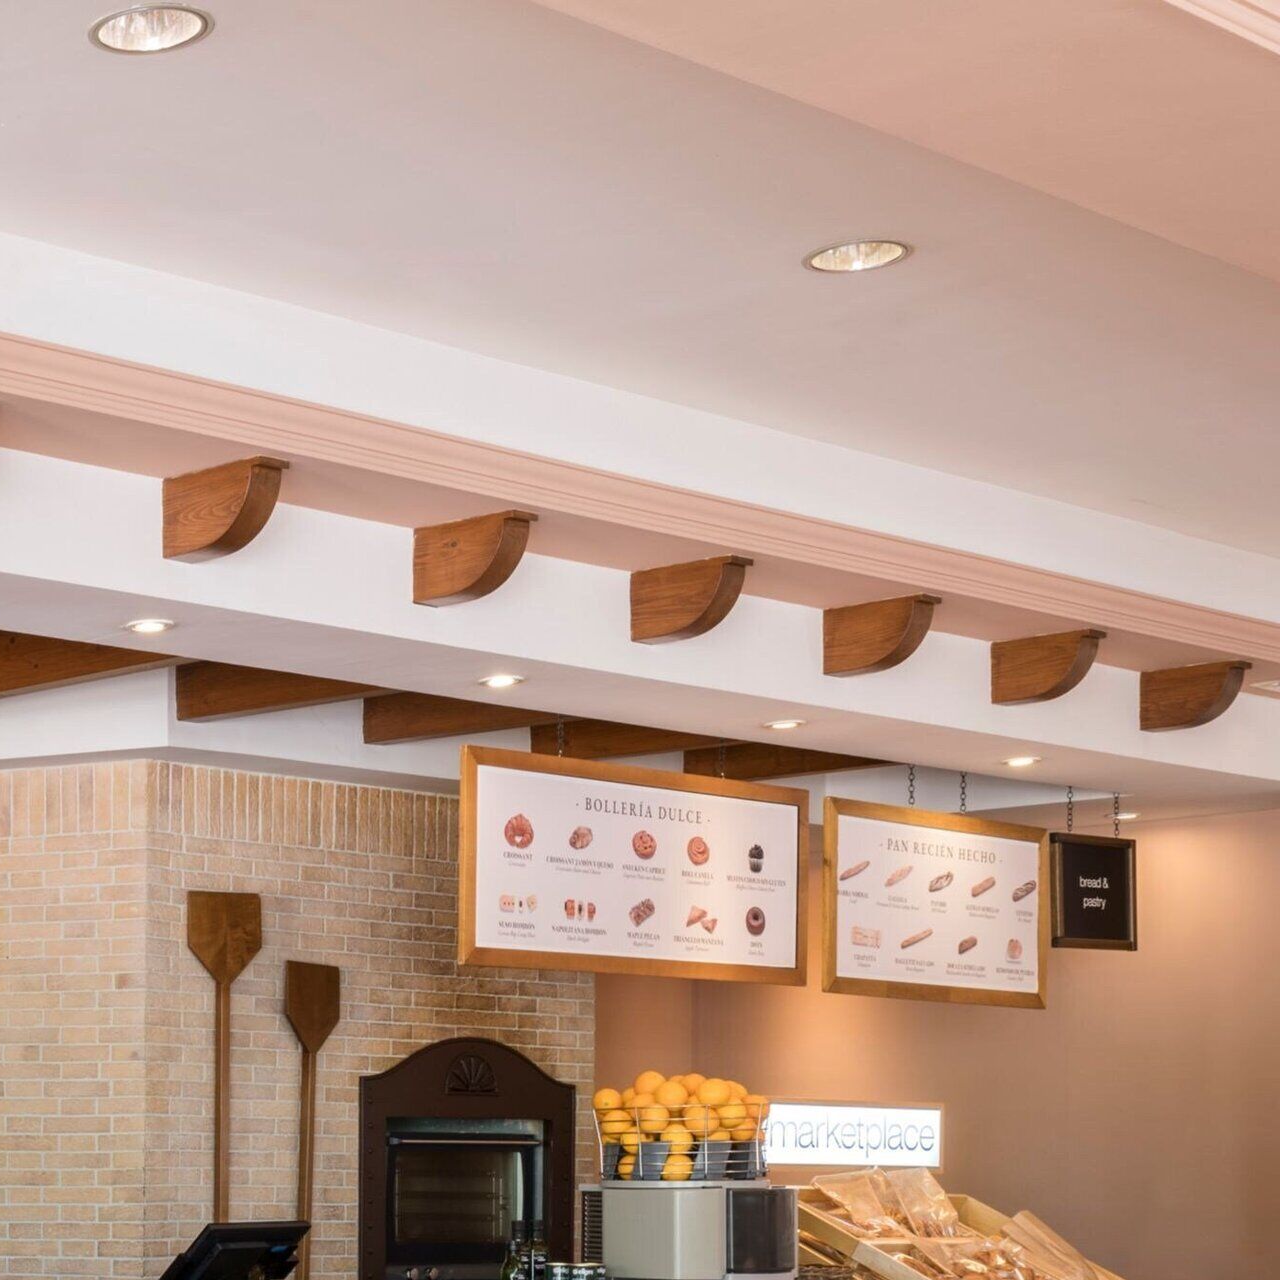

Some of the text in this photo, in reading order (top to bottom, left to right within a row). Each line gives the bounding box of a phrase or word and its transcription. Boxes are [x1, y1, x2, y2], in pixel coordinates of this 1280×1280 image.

[585, 796, 703, 824] BOLLERÍA DULCE
[887, 838, 909, 852] PAN
[958, 847, 996, 864] HECHO
[1079, 875, 1110, 889] bread &
[1083, 896, 1107, 910] pastry
[769, 1112, 935, 1158] marketplace
